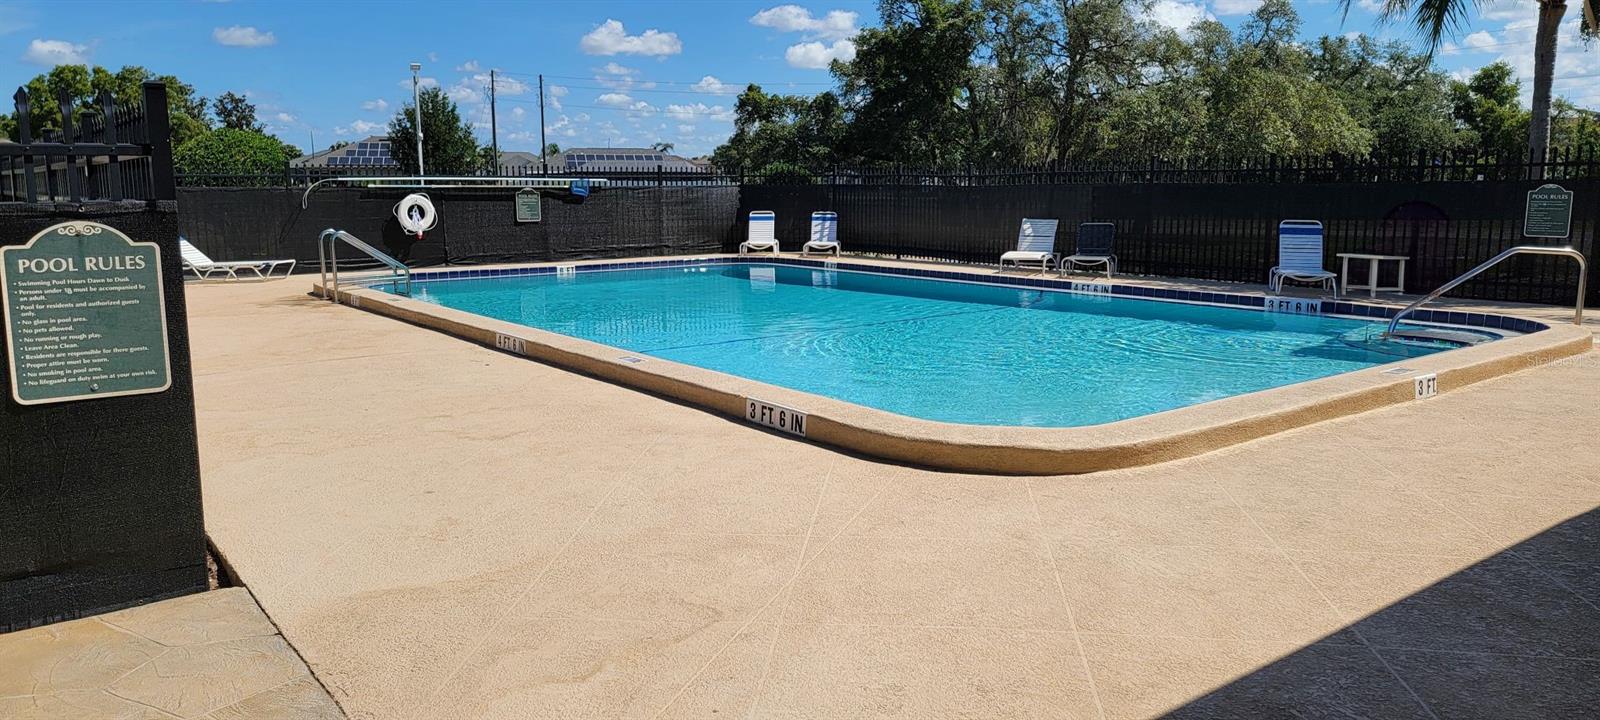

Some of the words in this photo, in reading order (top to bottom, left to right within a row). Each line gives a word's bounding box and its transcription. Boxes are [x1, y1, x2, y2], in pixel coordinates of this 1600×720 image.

[18, 257, 79, 273] POOL
[85, 255, 146, 271] RULES
[1269, 300, 1274, 309] 3
[1296, 302, 1302, 312] 6
[1418, 380, 1423, 396] 3
[750, 402, 756, 418] 3
[780, 410, 786, 428] 6
